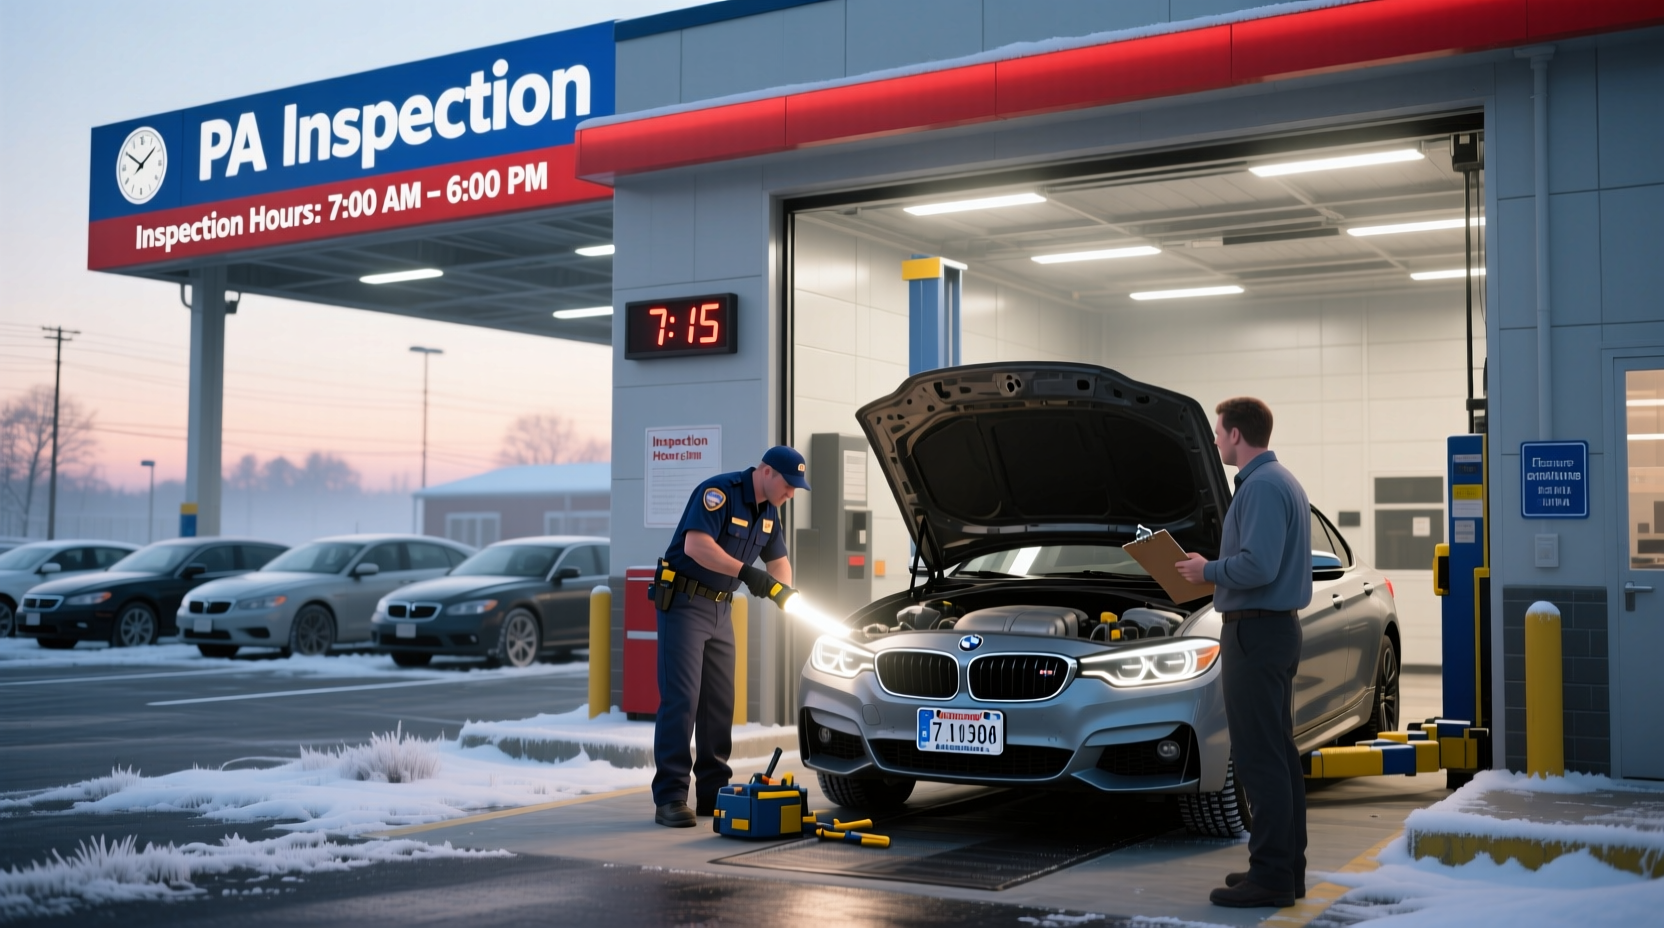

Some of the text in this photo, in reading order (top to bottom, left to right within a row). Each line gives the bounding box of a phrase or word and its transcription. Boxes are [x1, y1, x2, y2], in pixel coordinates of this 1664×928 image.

[199, 58, 591, 182] PA Inspection
[135, 214, 244, 253] Inspection
[249, 203, 322, 234] Hours:
[327, 187, 378, 221] 7:00
[381, 180, 422, 214] AM
[446, 168, 501, 204] 6:00
[507, 161, 548, 195] PM
[649, 303, 720, 346] 7:15
